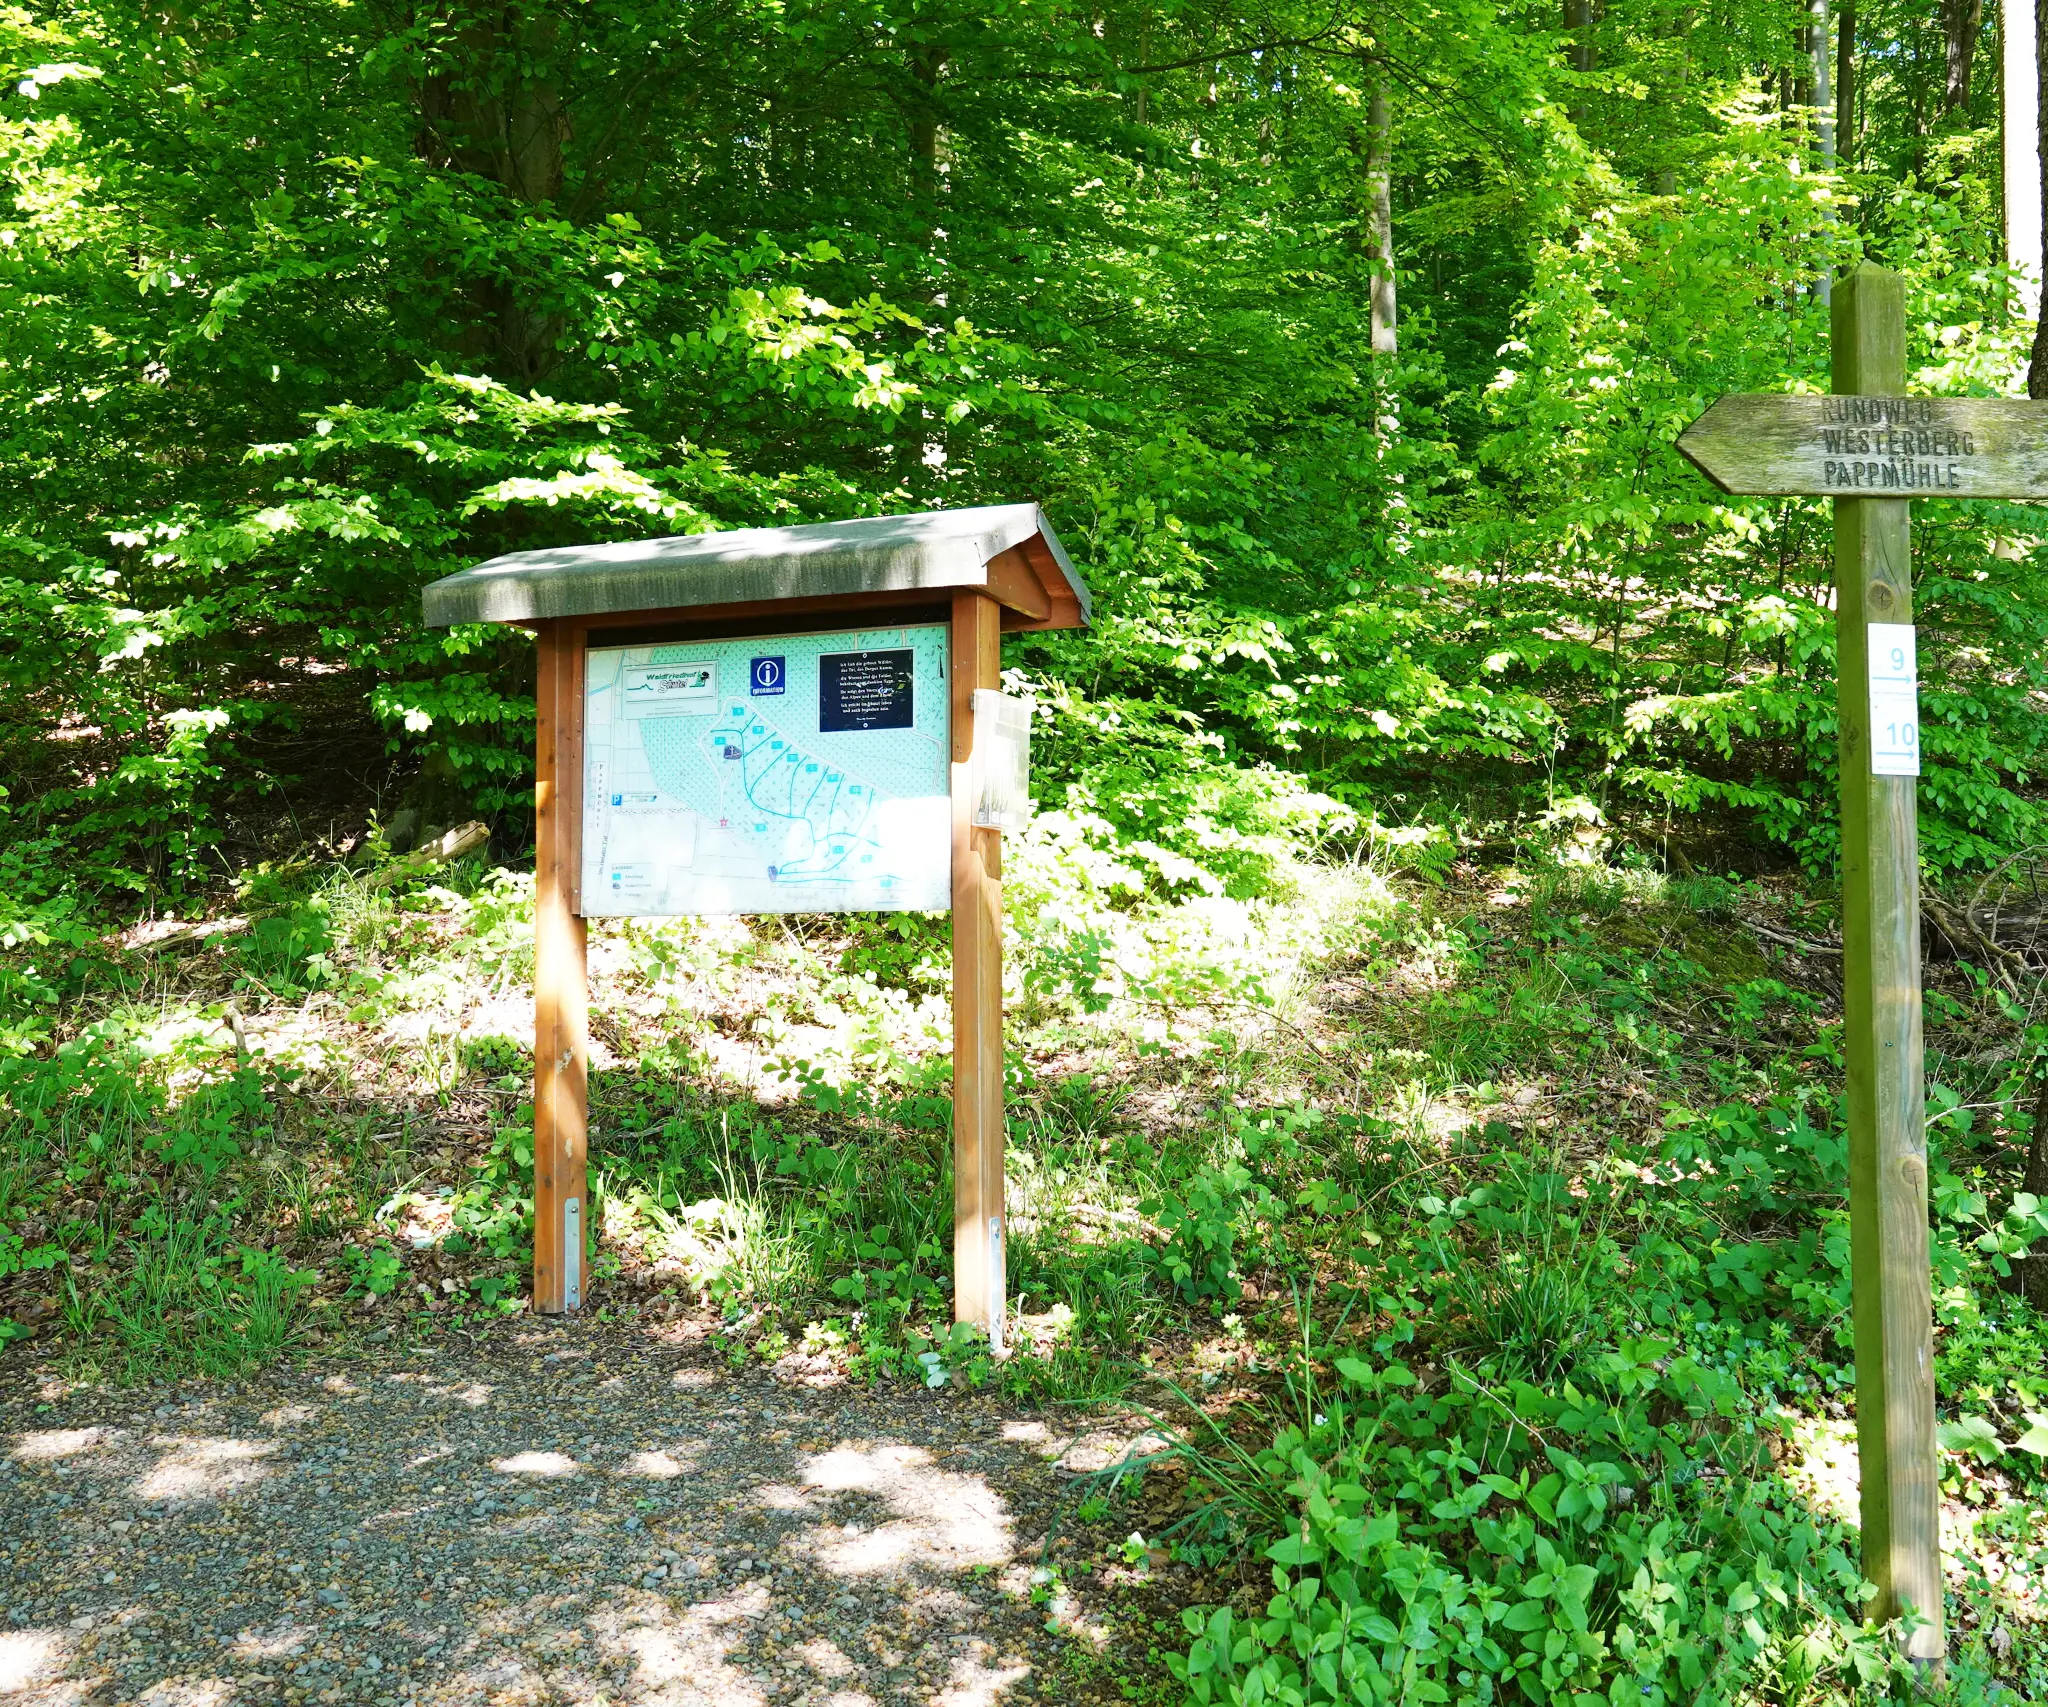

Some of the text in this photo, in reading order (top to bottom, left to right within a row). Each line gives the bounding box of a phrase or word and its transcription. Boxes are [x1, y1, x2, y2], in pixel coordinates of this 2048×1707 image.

[1823, 429, 1974, 456] WESTERBERG
[1824, 458, 1961, 489] PAPPMÜHLE
[1891, 647, 1905, 671] 9
[646, 671, 697, 680] Waldfriedhof
[1887, 722, 1916, 746] 10
